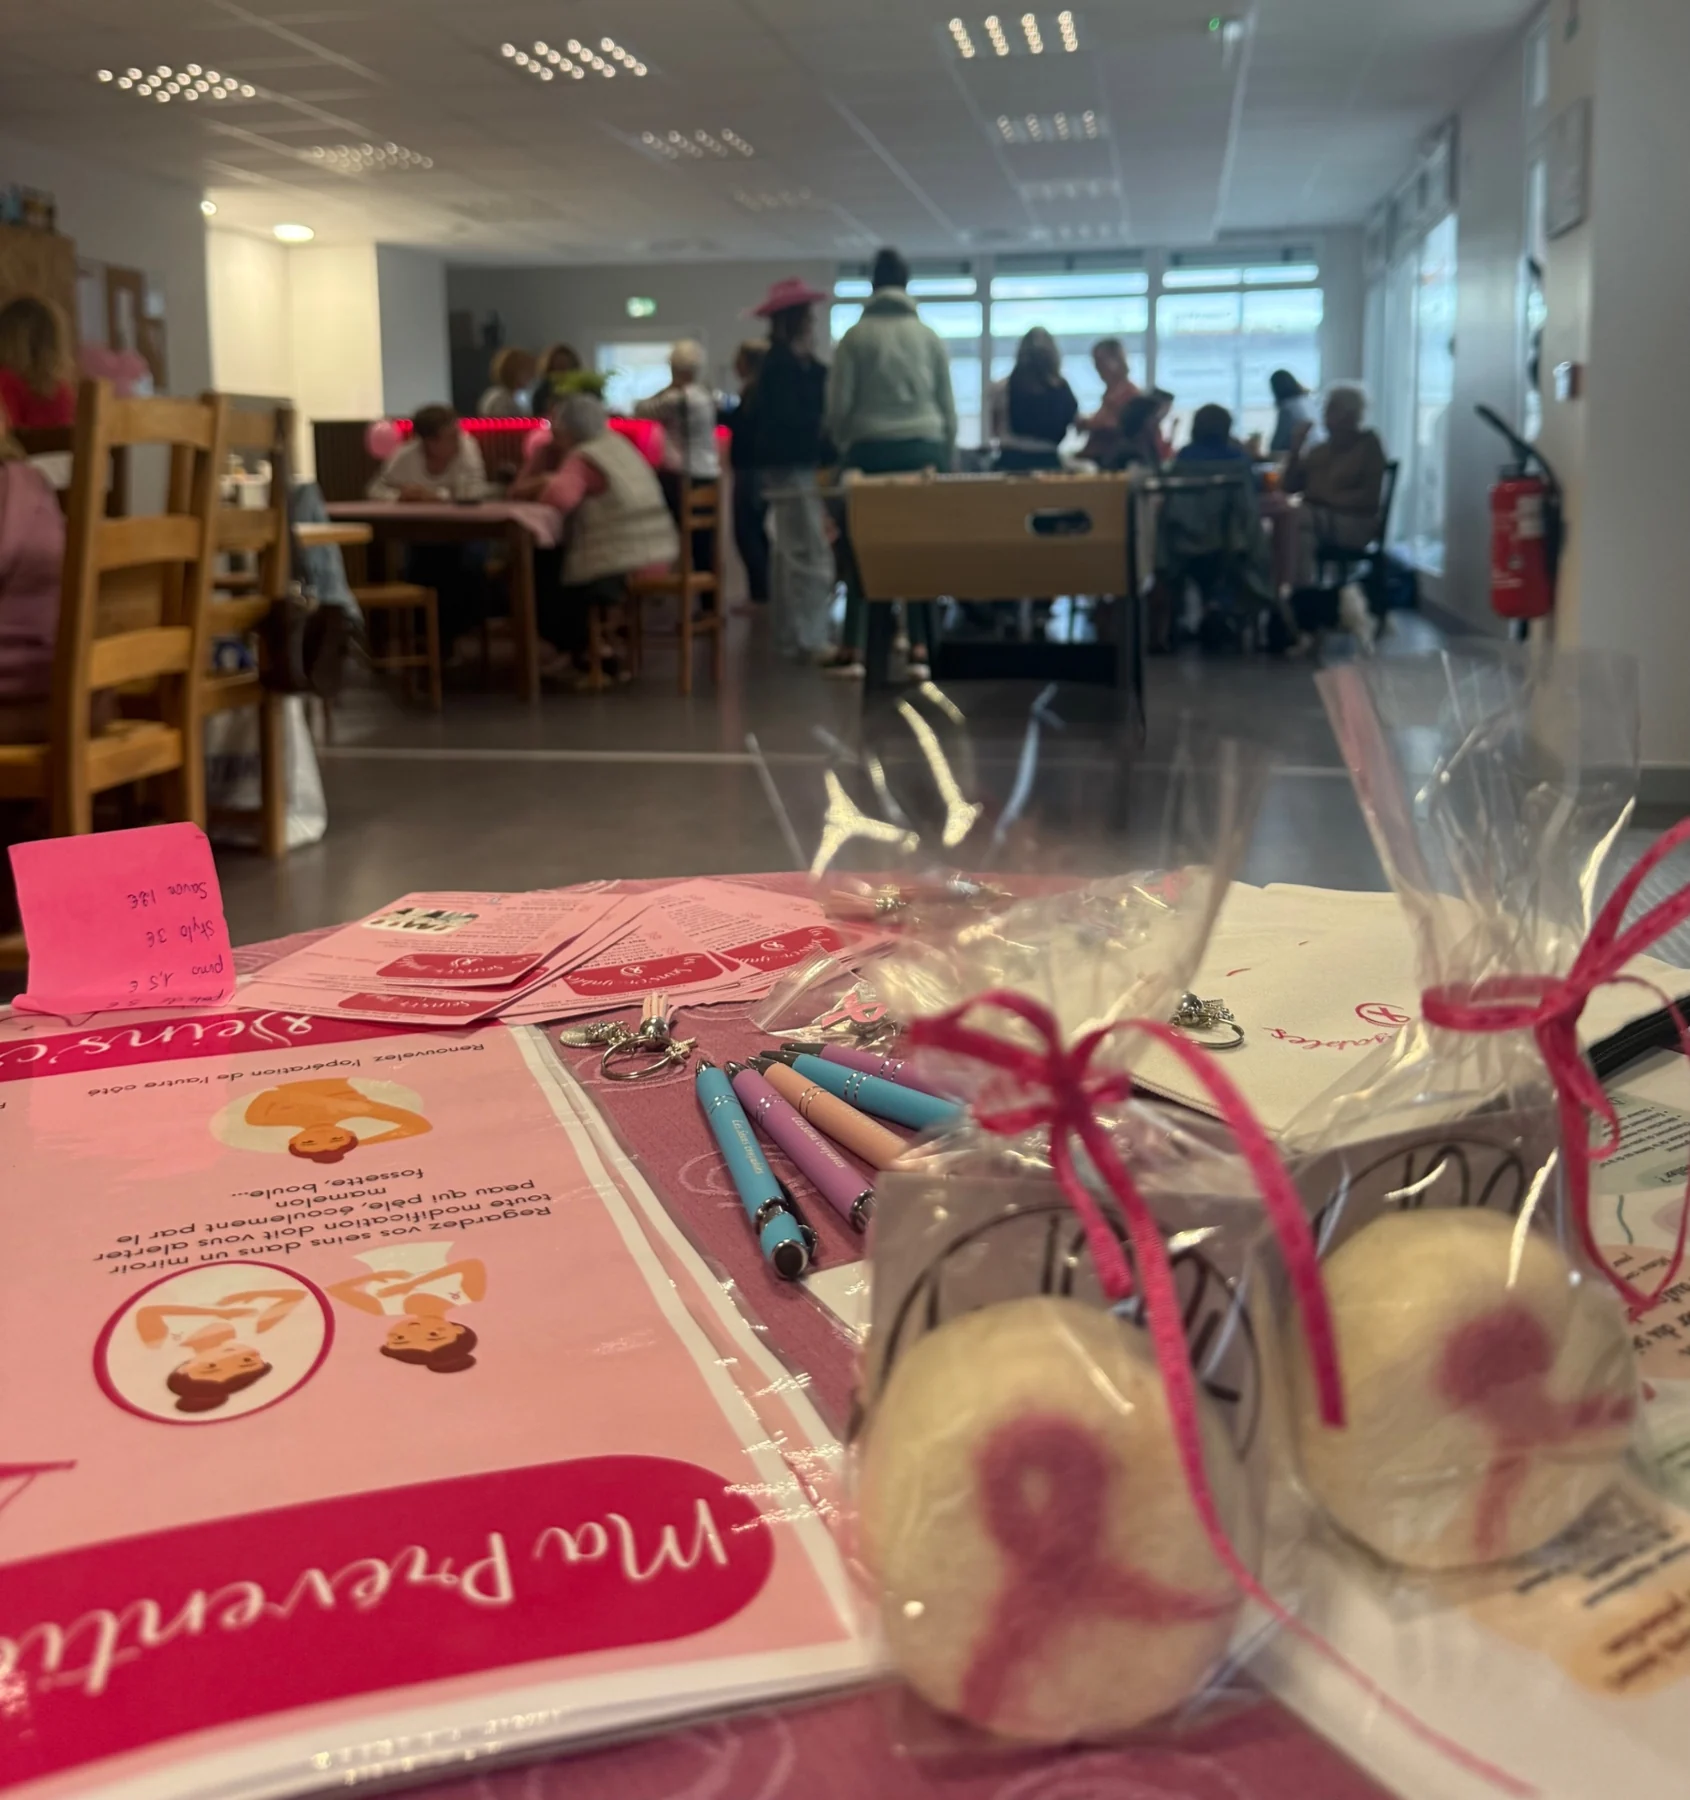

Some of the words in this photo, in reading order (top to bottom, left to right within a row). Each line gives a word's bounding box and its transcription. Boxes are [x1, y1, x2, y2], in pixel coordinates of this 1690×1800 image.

[167, 882, 207, 899] Savon
[372, 1043, 485, 1063] Renouvelez
[250, 1058, 361, 1077] l'opération
[144, 1075, 209, 1089] l'autre
[217, 1071, 244, 1082] de
[87, 1084, 137, 1097] côté
[324, 1168, 424, 1188] fossette,
[231, 1183, 317, 1199] boule...
[432, 1189, 467, 1203] qui
[475, 1179, 535, 1196] peau
[274, 1187, 387, 1209] mamelon
[361, 1193, 422, 1211] pèle,
[489, 1194, 552, 1209] toute
[205, 1206, 354, 1232] écoulement
[324, 1203, 481, 1231] modification
[428, 1206, 551, 1230] Regardez
[116, 1234, 140, 1246] le
[148, 1223, 196, 1240] par
[263, 1225, 314, 1240] doit
[310, 1232, 371, 1247] seins
[379, 1226, 421, 1238] vos
[198, 1233, 254, 1248] vous
[237, 1241, 301, 1257] dans
[92, 1241, 188, 1262] alerter
[200, 1251, 228, 1262] un
[108, 1256, 188, 1275] miroir
[530, 1498, 728, 1581] Ma
